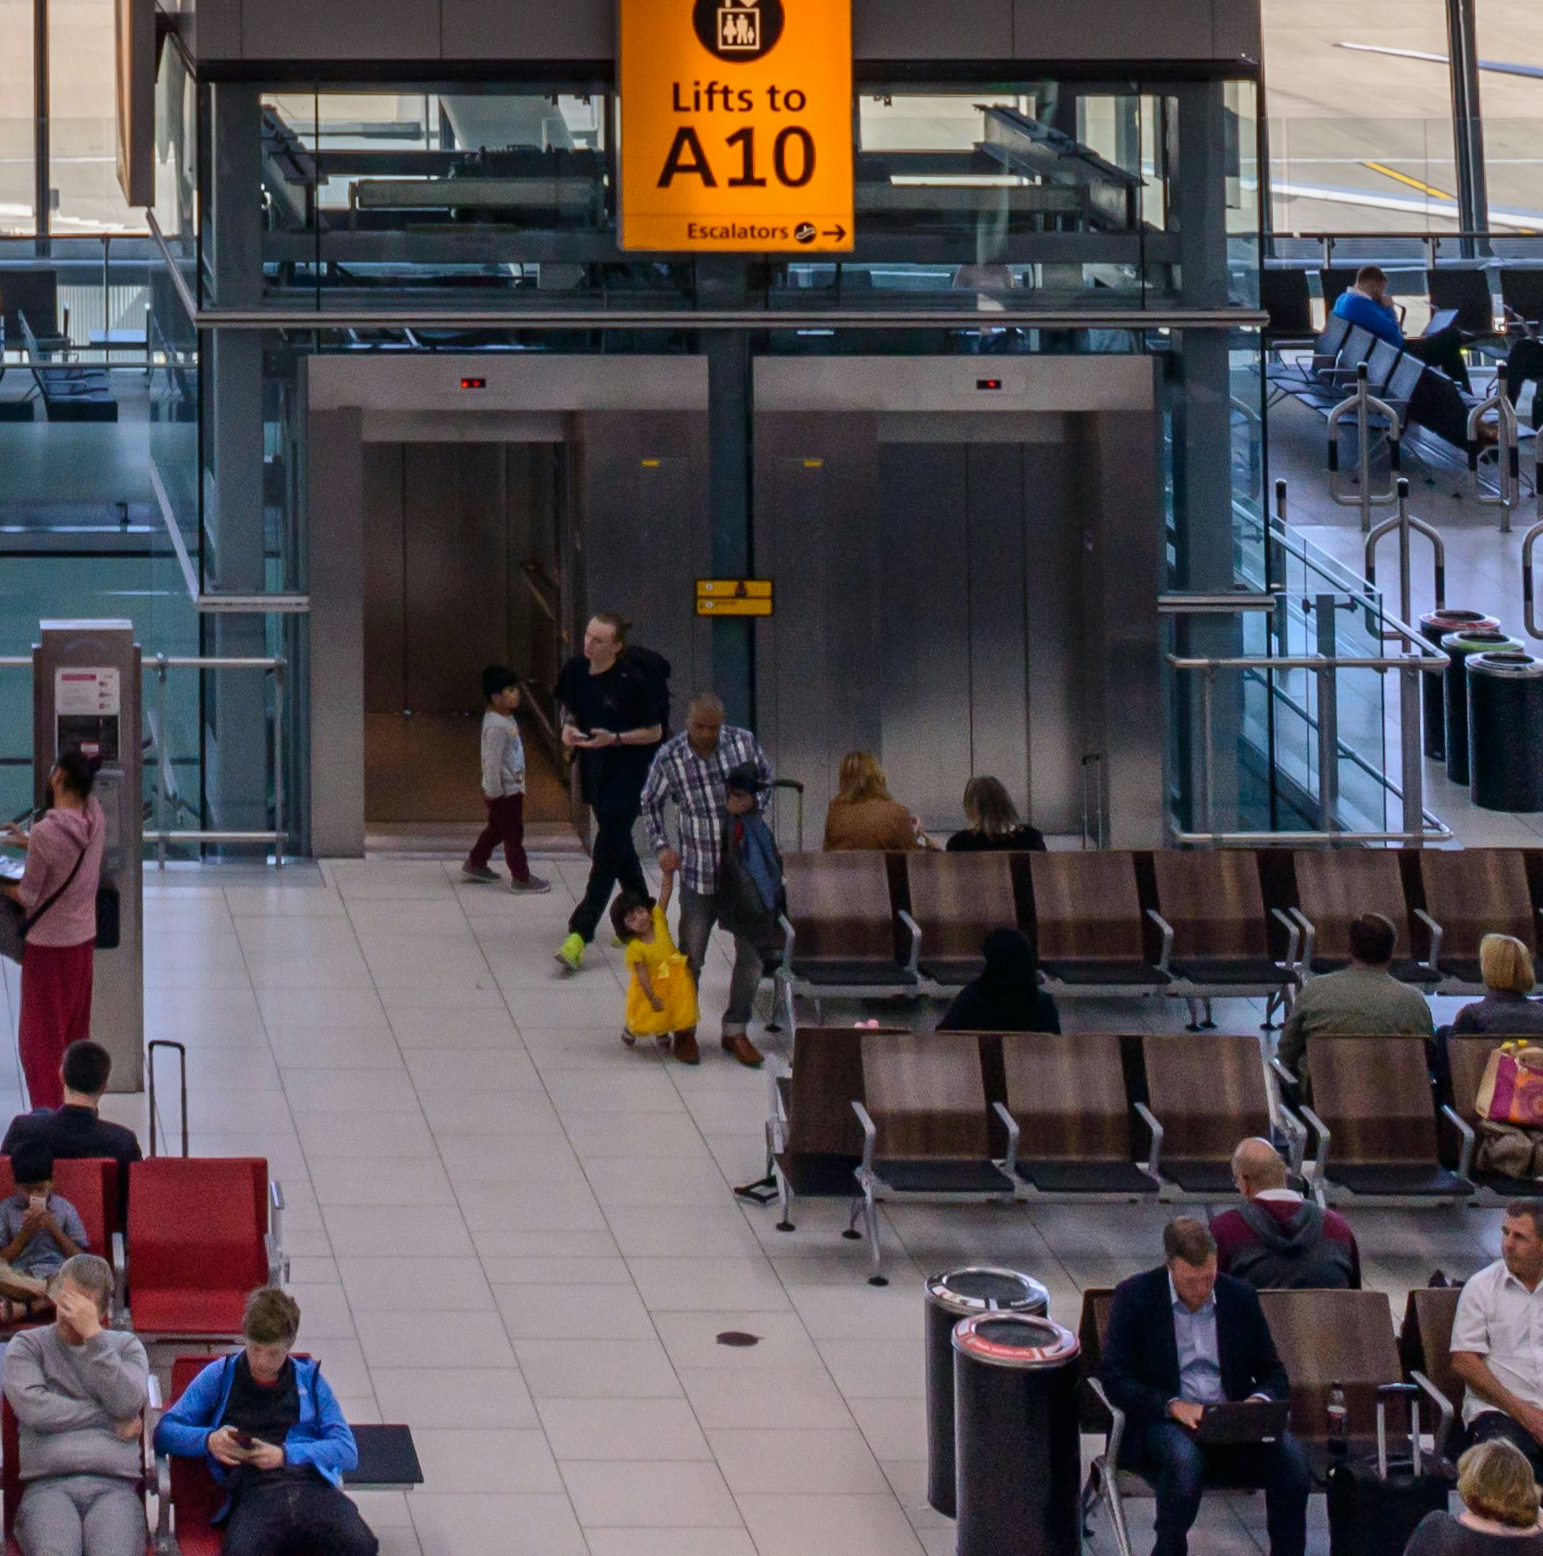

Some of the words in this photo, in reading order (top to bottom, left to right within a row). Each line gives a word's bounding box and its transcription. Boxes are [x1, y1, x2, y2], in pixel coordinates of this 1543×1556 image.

[672, 81, 754, 113] Lifts
[767, 85, 806, 112] to
[656, 125, 817, 188] A10
[687, 222, 789, 239] Escalators
